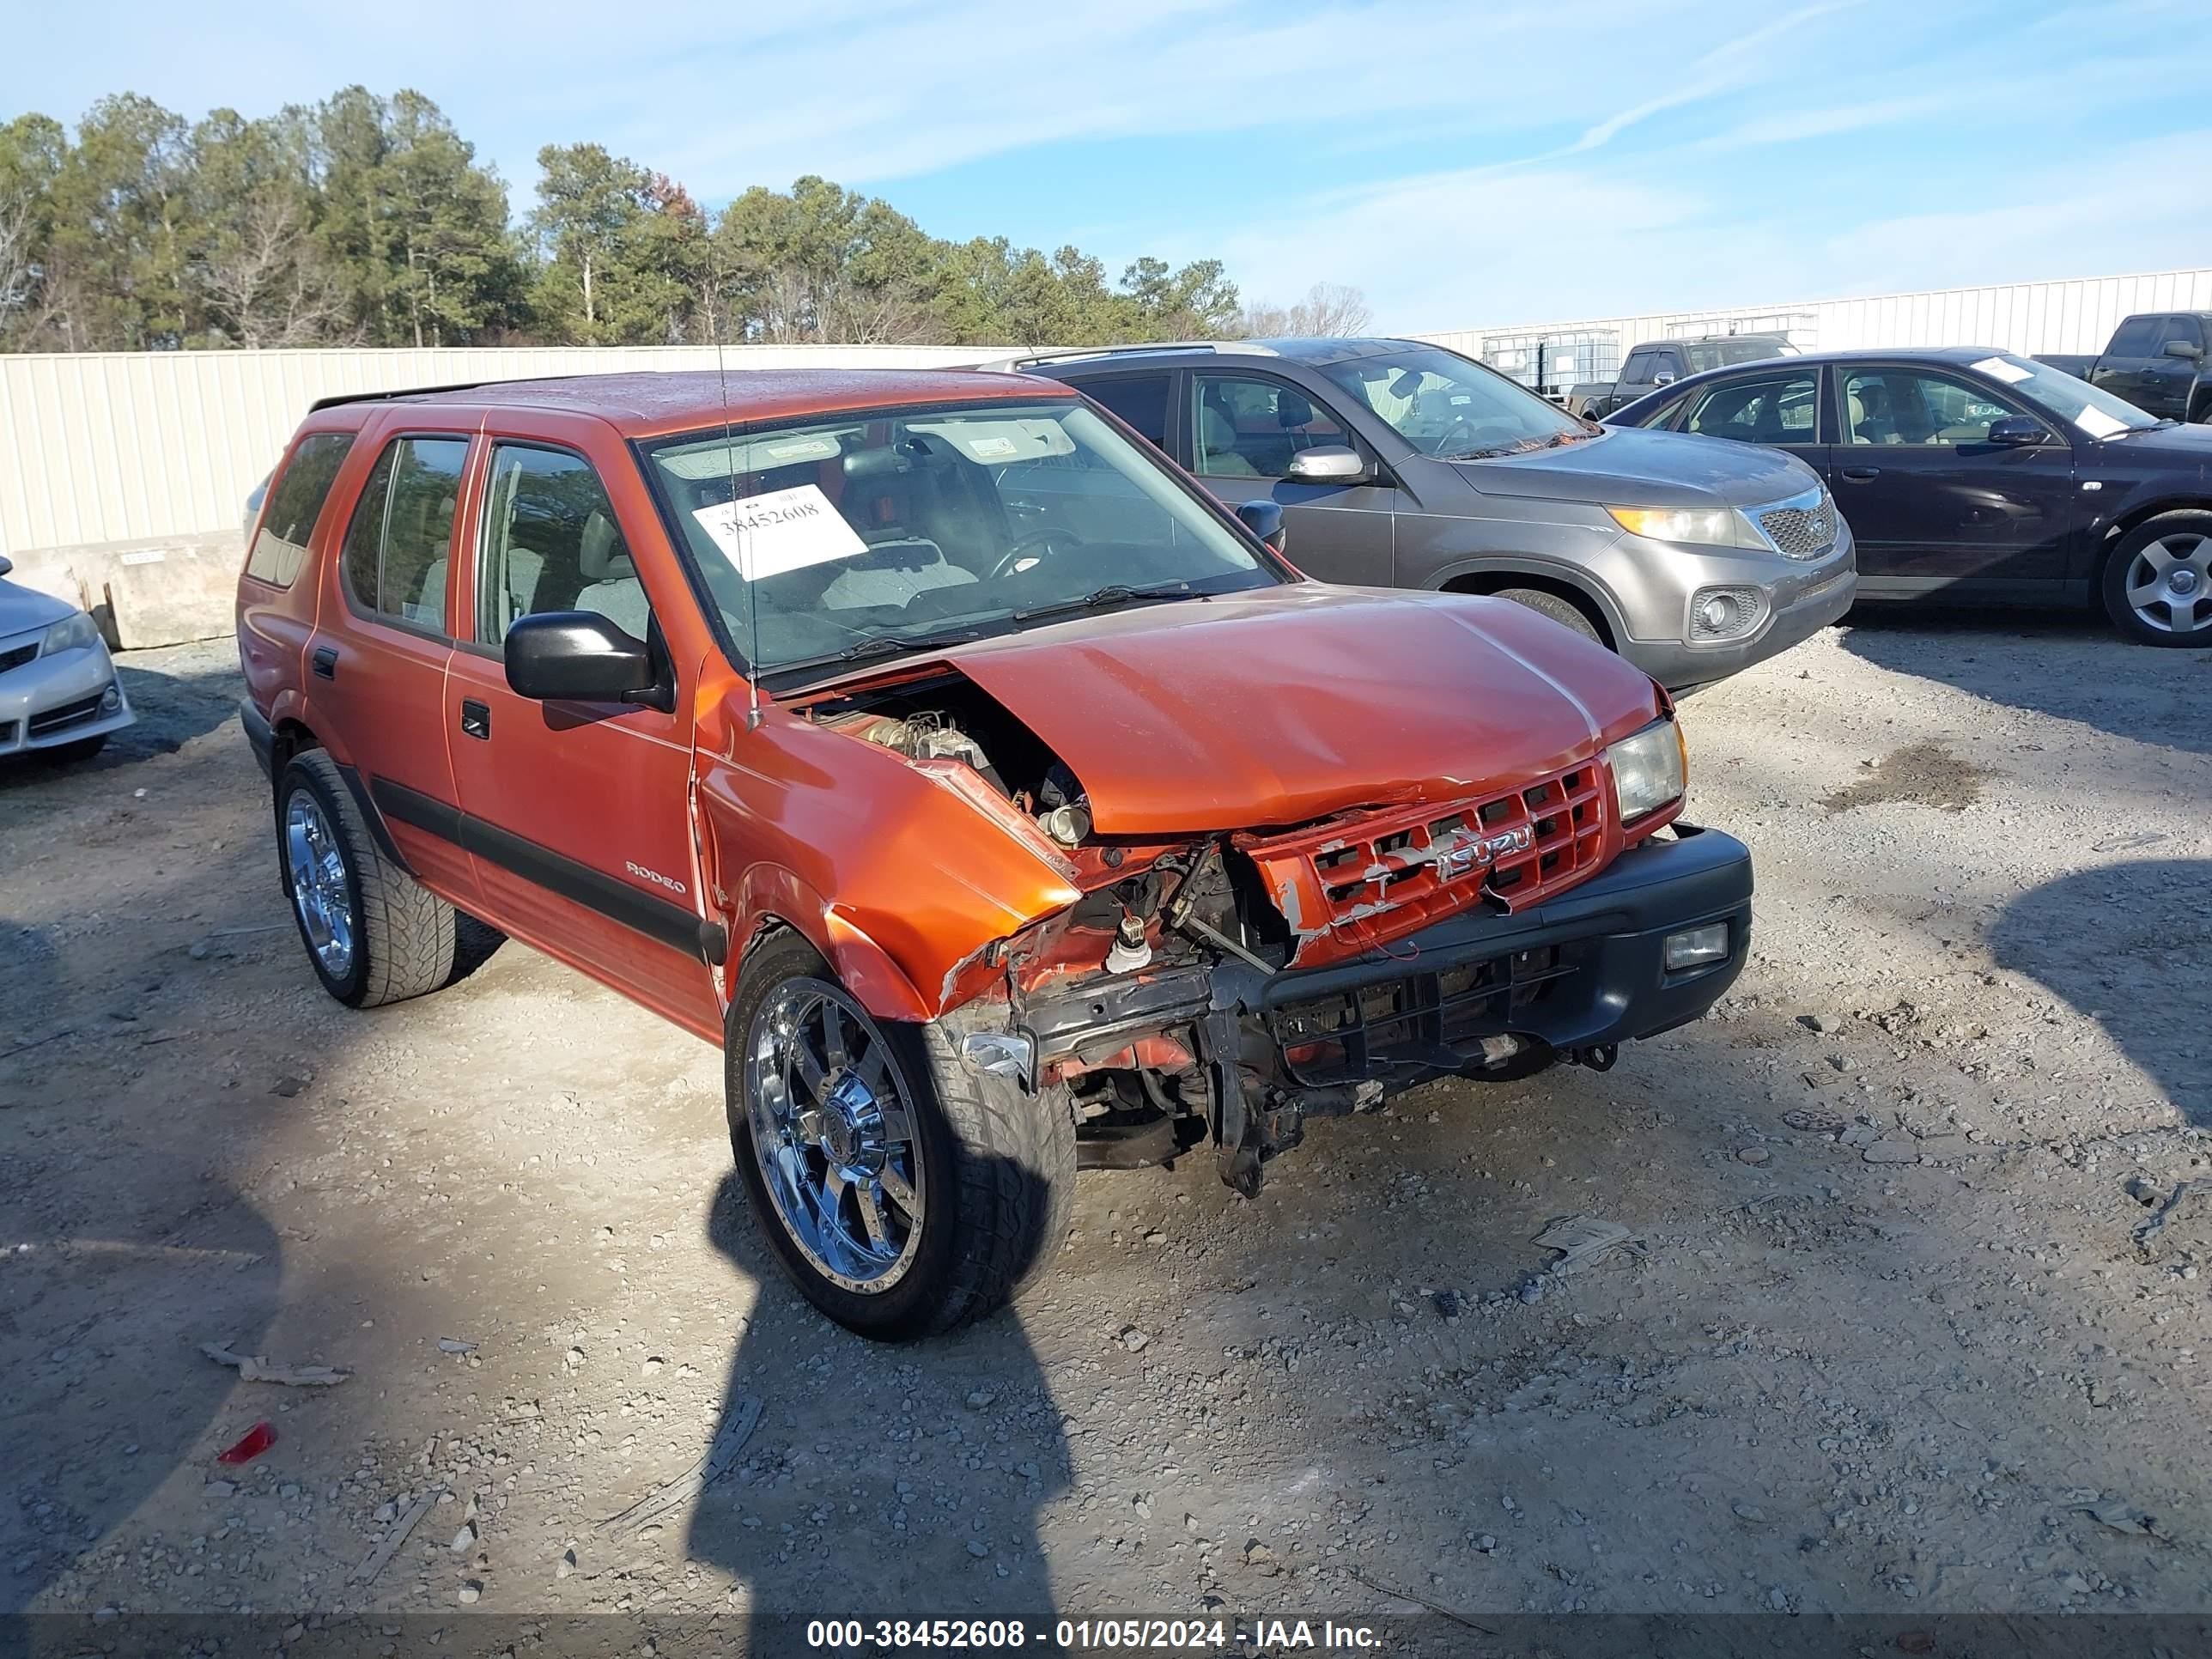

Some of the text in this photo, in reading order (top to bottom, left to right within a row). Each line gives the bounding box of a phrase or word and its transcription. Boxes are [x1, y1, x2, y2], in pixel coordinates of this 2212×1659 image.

[720, 502, 820, 536] 38452608
[1437, 823, 1534, 883] ISUZU
[626, 861, 686, 894] RODEO
